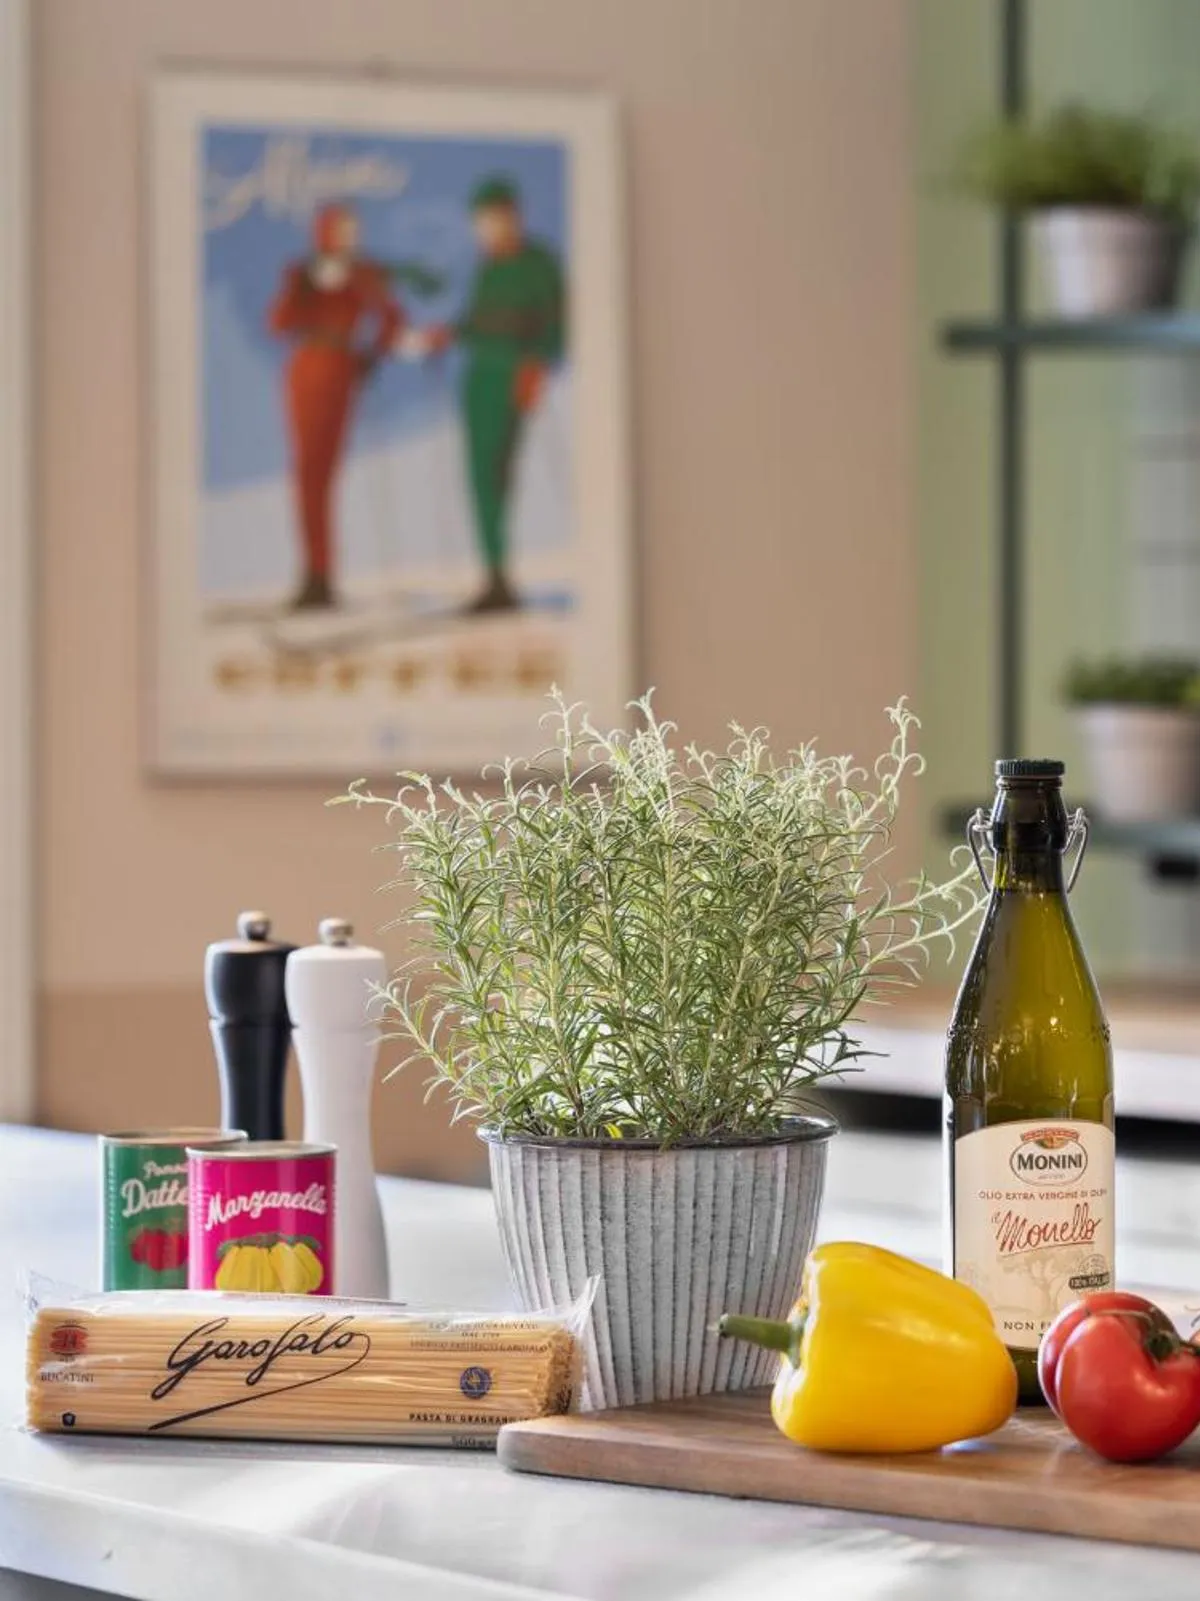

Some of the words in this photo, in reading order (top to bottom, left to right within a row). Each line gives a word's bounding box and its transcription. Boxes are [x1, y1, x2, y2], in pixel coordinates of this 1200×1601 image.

[1017, 1153, 1082, 1170] MONINI
[978, 1190, 1003, 1200] OLIO
[1005, 1191, 1036, 1201] EXTRA
[1039, 1191, 1078, 1201] VERGINE
[1003, 1321, 1034, 1330] NON
[150, 1314, 370, 1400] Garofalo
[40, 1371, 95, 1383] BUCATINI
[408, 1413, 441, 1422] PASTA
[445, 1413, 456, 1422] DI
